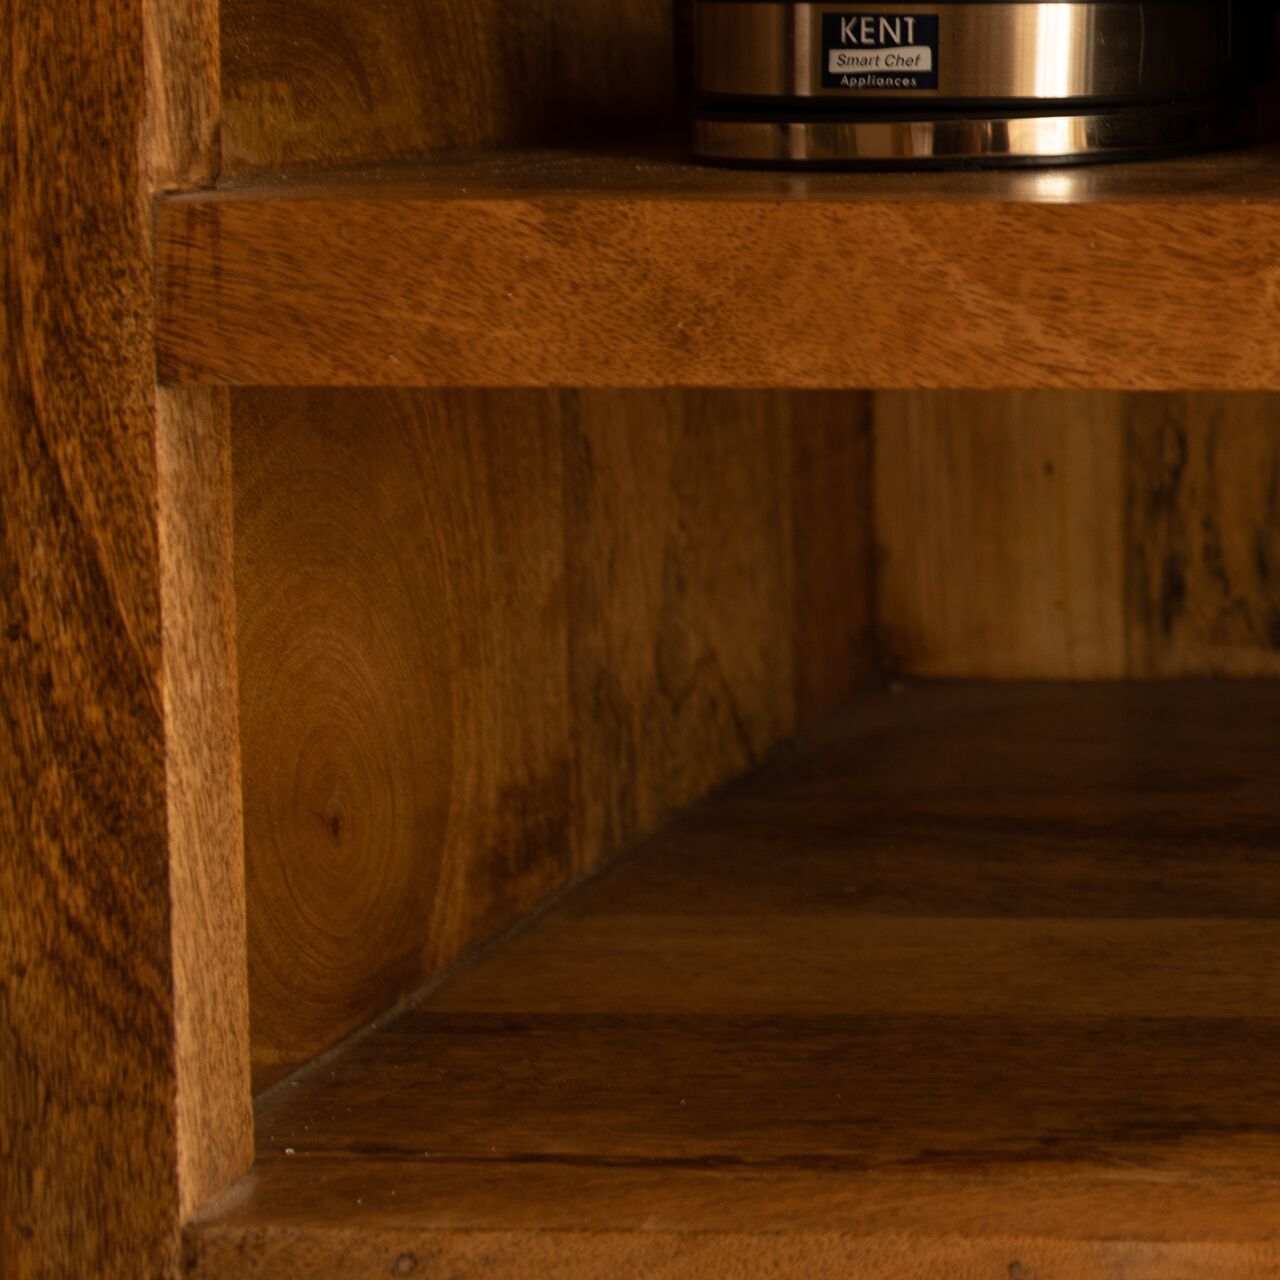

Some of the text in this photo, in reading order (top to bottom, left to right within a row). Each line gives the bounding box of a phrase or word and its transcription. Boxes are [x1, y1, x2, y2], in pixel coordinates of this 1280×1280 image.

[840, 16, 915, 45] KENT
[837, 54, 921, 67] Smart Chef
[839, 74, 918, 89] Appliances
